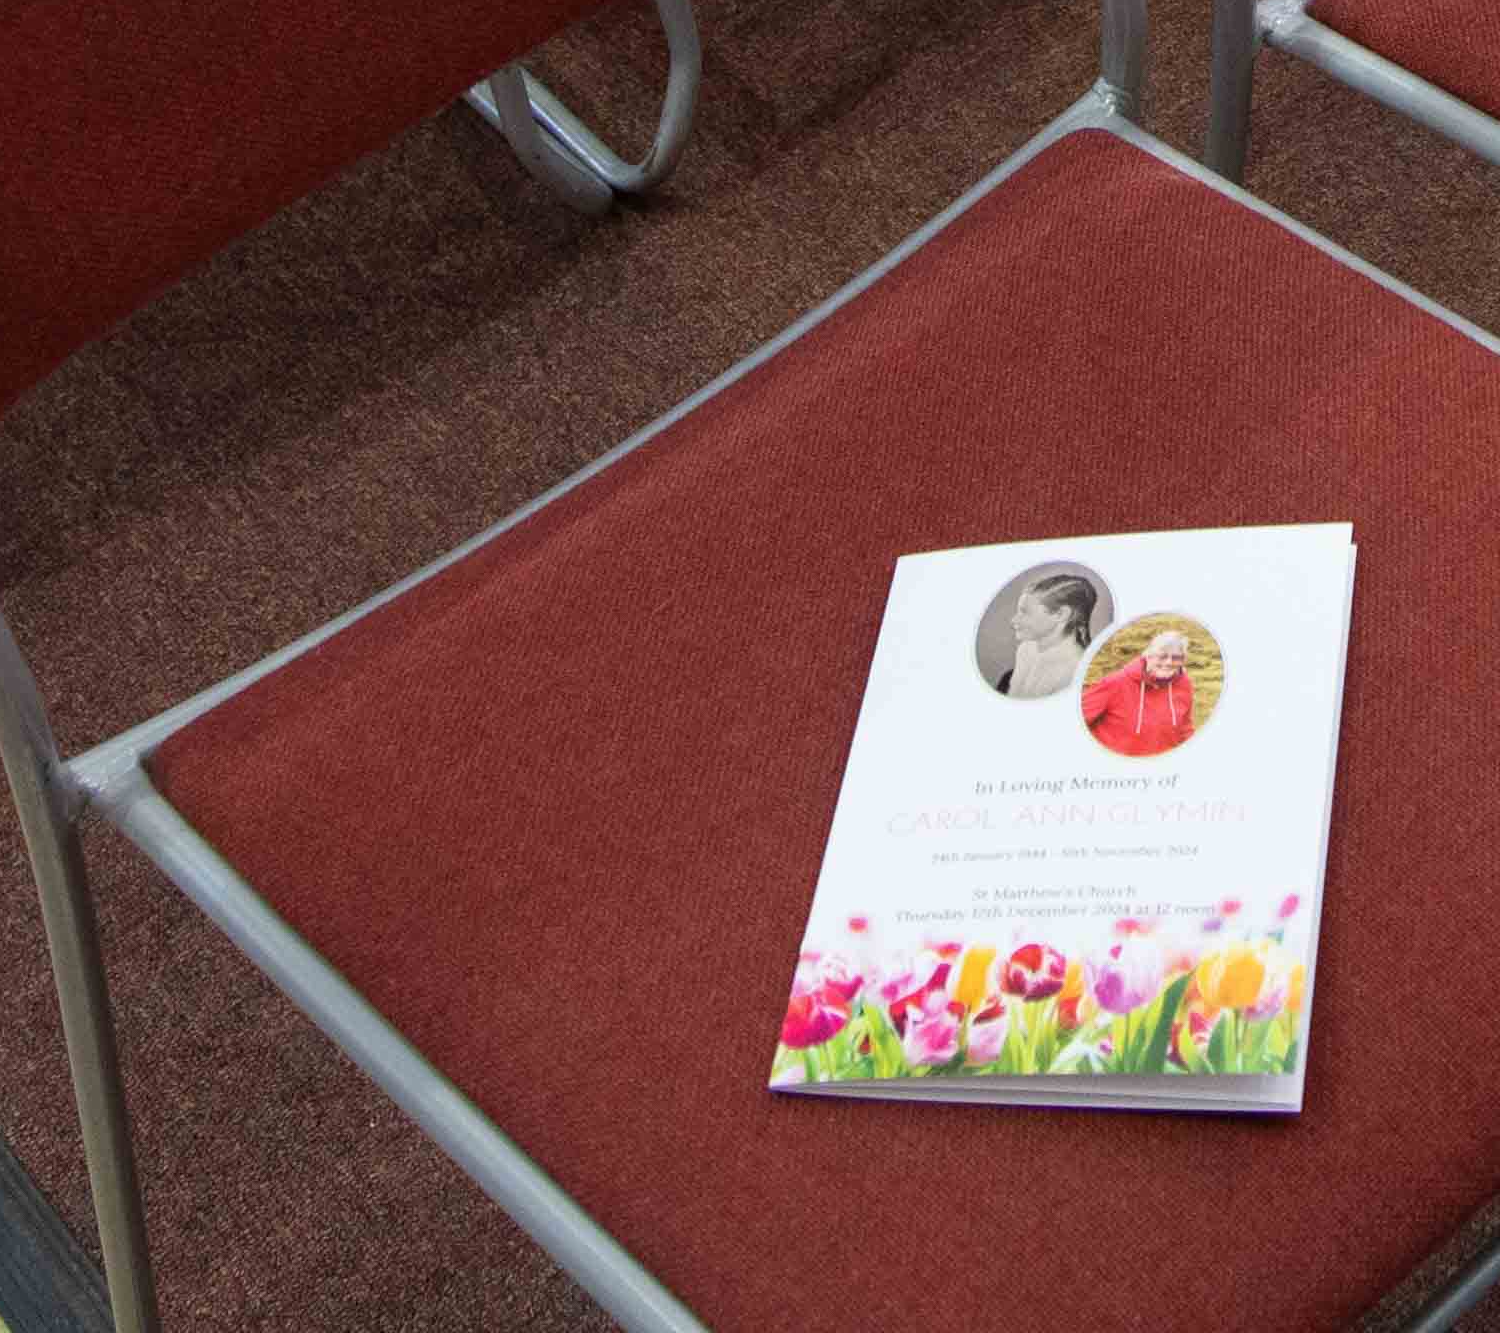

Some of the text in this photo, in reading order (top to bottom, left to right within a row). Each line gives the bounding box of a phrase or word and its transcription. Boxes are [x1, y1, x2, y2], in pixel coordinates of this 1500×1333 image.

[974, 773, 1180, 798] In Loving Memory of
[886, 805, 996, 837] CAROL
[1012, 803, 1095, 829] ANN
[972, 886, 989, 900] St
[1077, 883, 1138, 900] Church
[894, 907, 965, 925] Thursday
[1008, 902, 1089, 919] December
